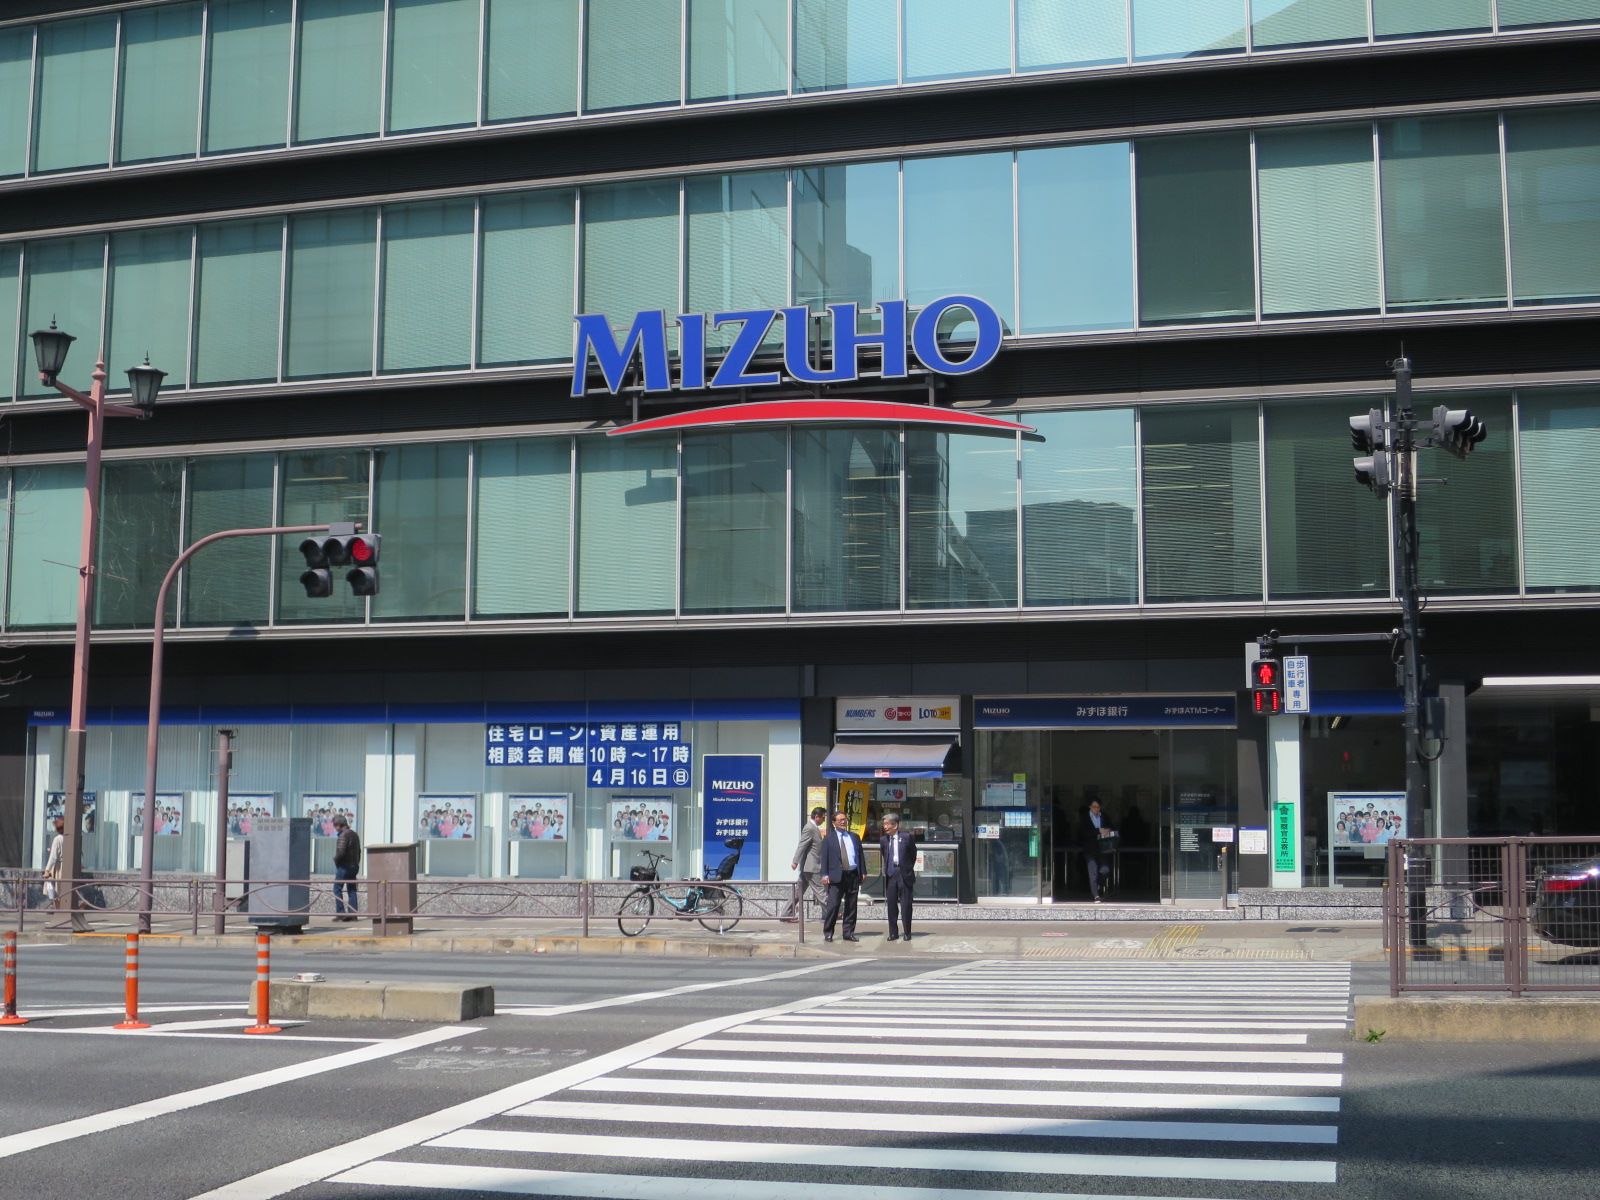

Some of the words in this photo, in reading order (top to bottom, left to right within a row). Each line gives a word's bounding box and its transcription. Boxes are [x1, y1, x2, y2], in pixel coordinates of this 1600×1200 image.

[570, 294, 1003, 397] MIZUHO
[845, 709, 876, 718] NUMBERS
[1076, 706, 1128, 717] みずほ銀行
[1164, 706, 1226, 715] みずほATMコーナー
[488, 724, 679, 742] 住宅ローン・資産運用
[712, 780, 754, 790] MIZUHO
